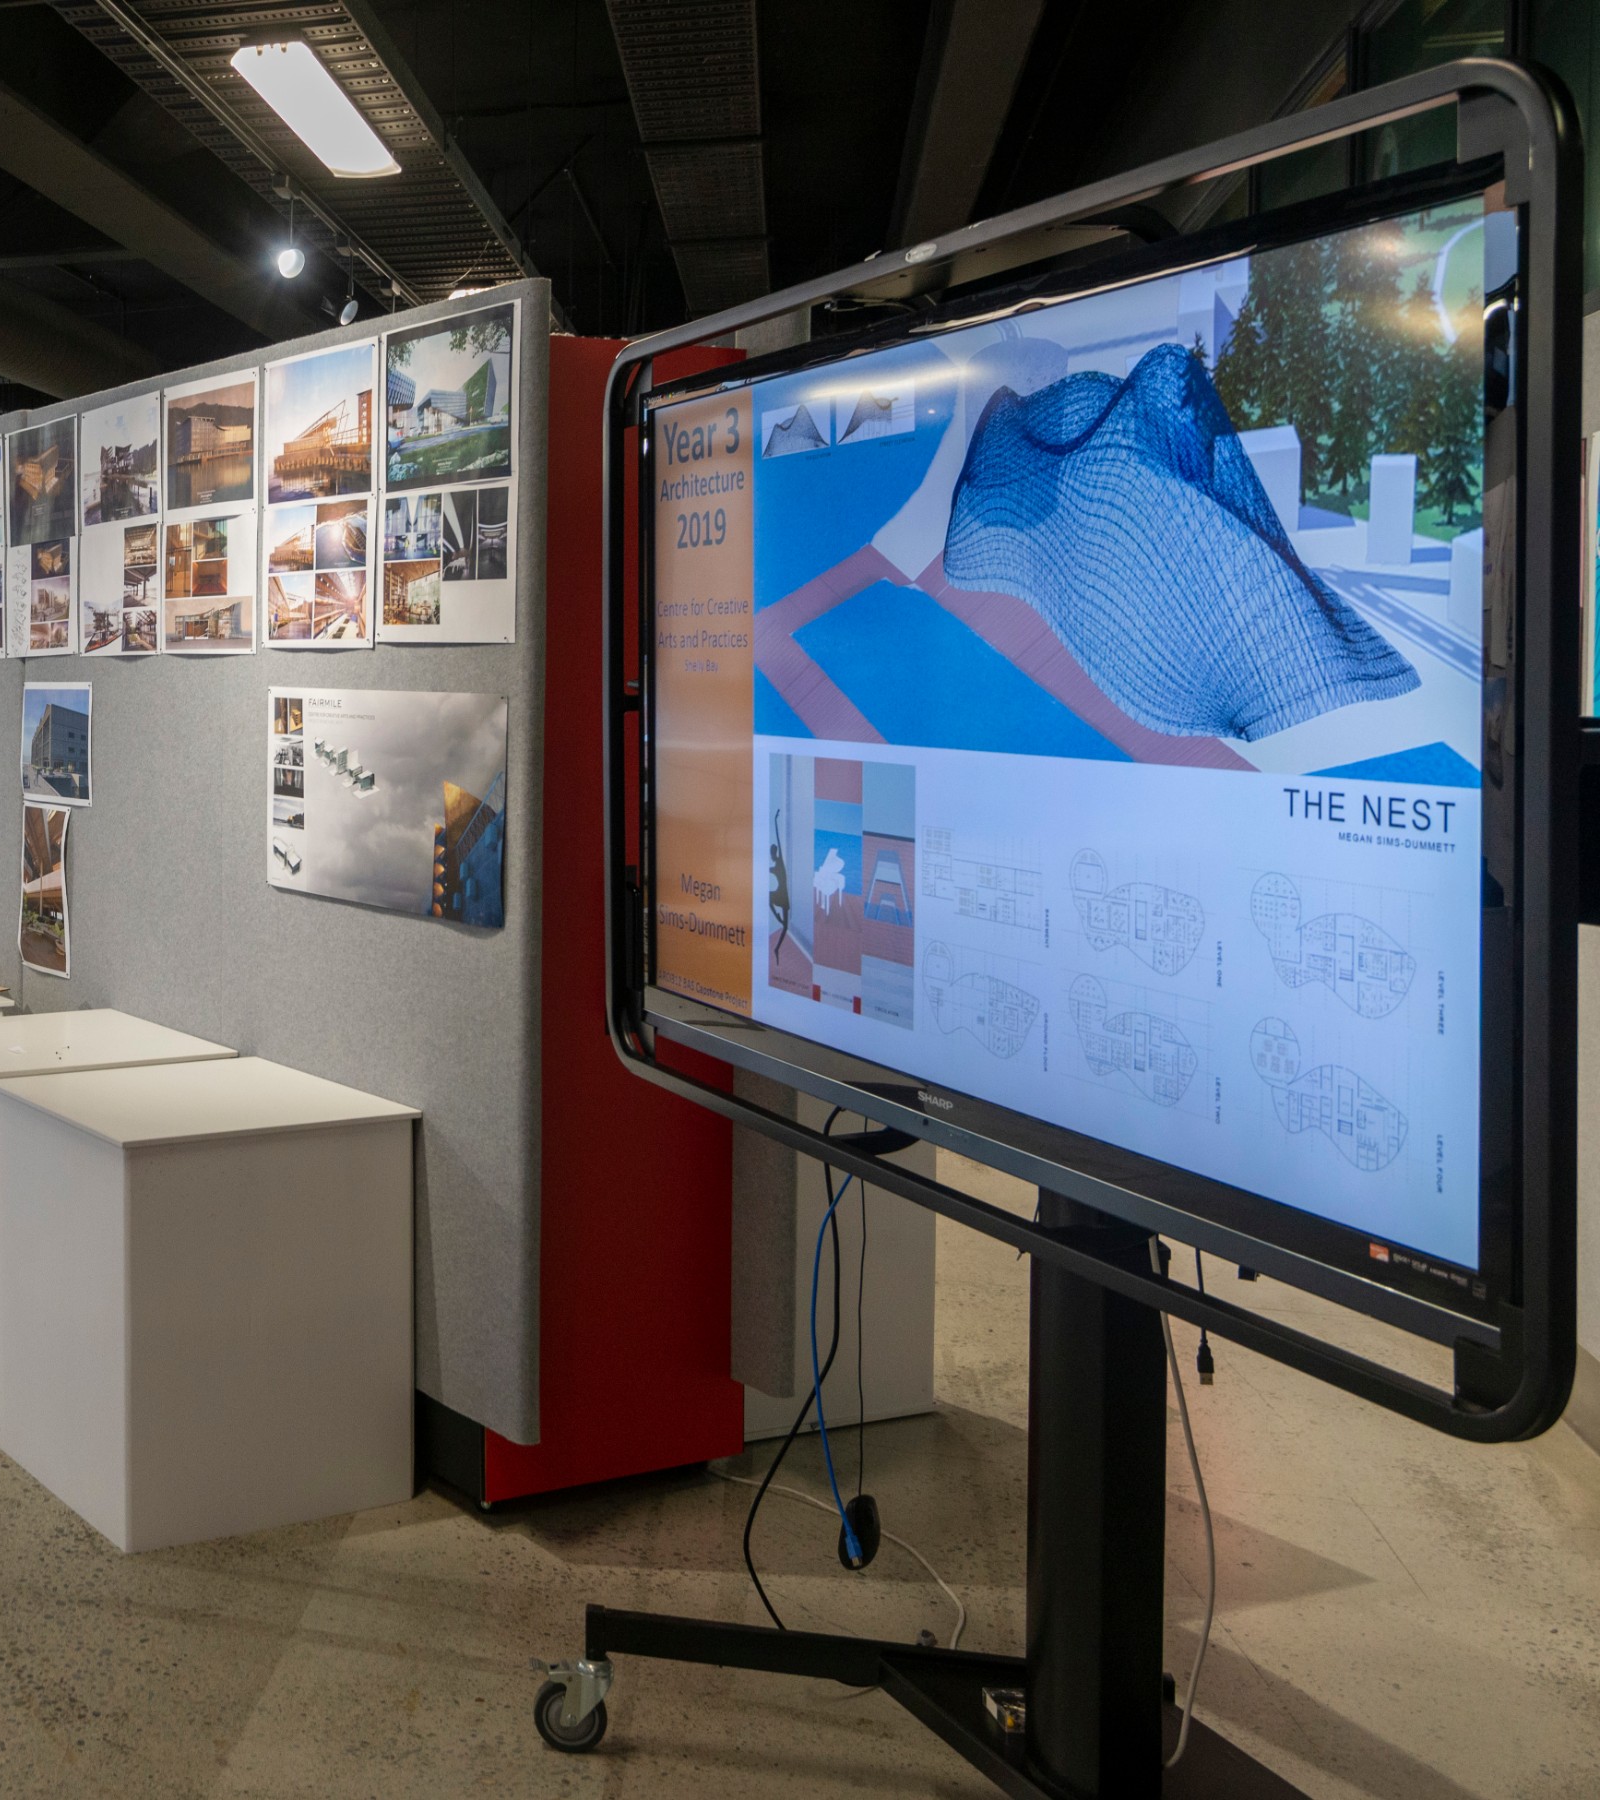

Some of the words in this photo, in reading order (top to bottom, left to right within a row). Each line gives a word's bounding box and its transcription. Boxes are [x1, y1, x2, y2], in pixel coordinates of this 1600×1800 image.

[663, 421, 716, 465] Year
[725, 407, 740, 454] 3
[660, 471, 744, 502] Architecture
[677, 508, 726, 549] 2019
[657, 600, 688, 617] Centre
[691, 598, 704, 616] for
[707, 597, 749, 615] Creative
[658, 631, 677, 648] Arts
[680, 629, 698, 648] and
[702, 629, 748, 648] Practices
[308, 698, 343, 708] FAIRMILE
[1283, 788, 1345, 822] THE
[1362, 795, 1456, 833] NEST
[1338, 832, 1373, 844] MEGAN
[1376, 836, 1456, 853] SIMS-DUMMETT
[681, 872, 721, 903] Megan
[658, 904, 745, 947] Sims-Dummett
[917, 1090, 953, 1110] SHARP
